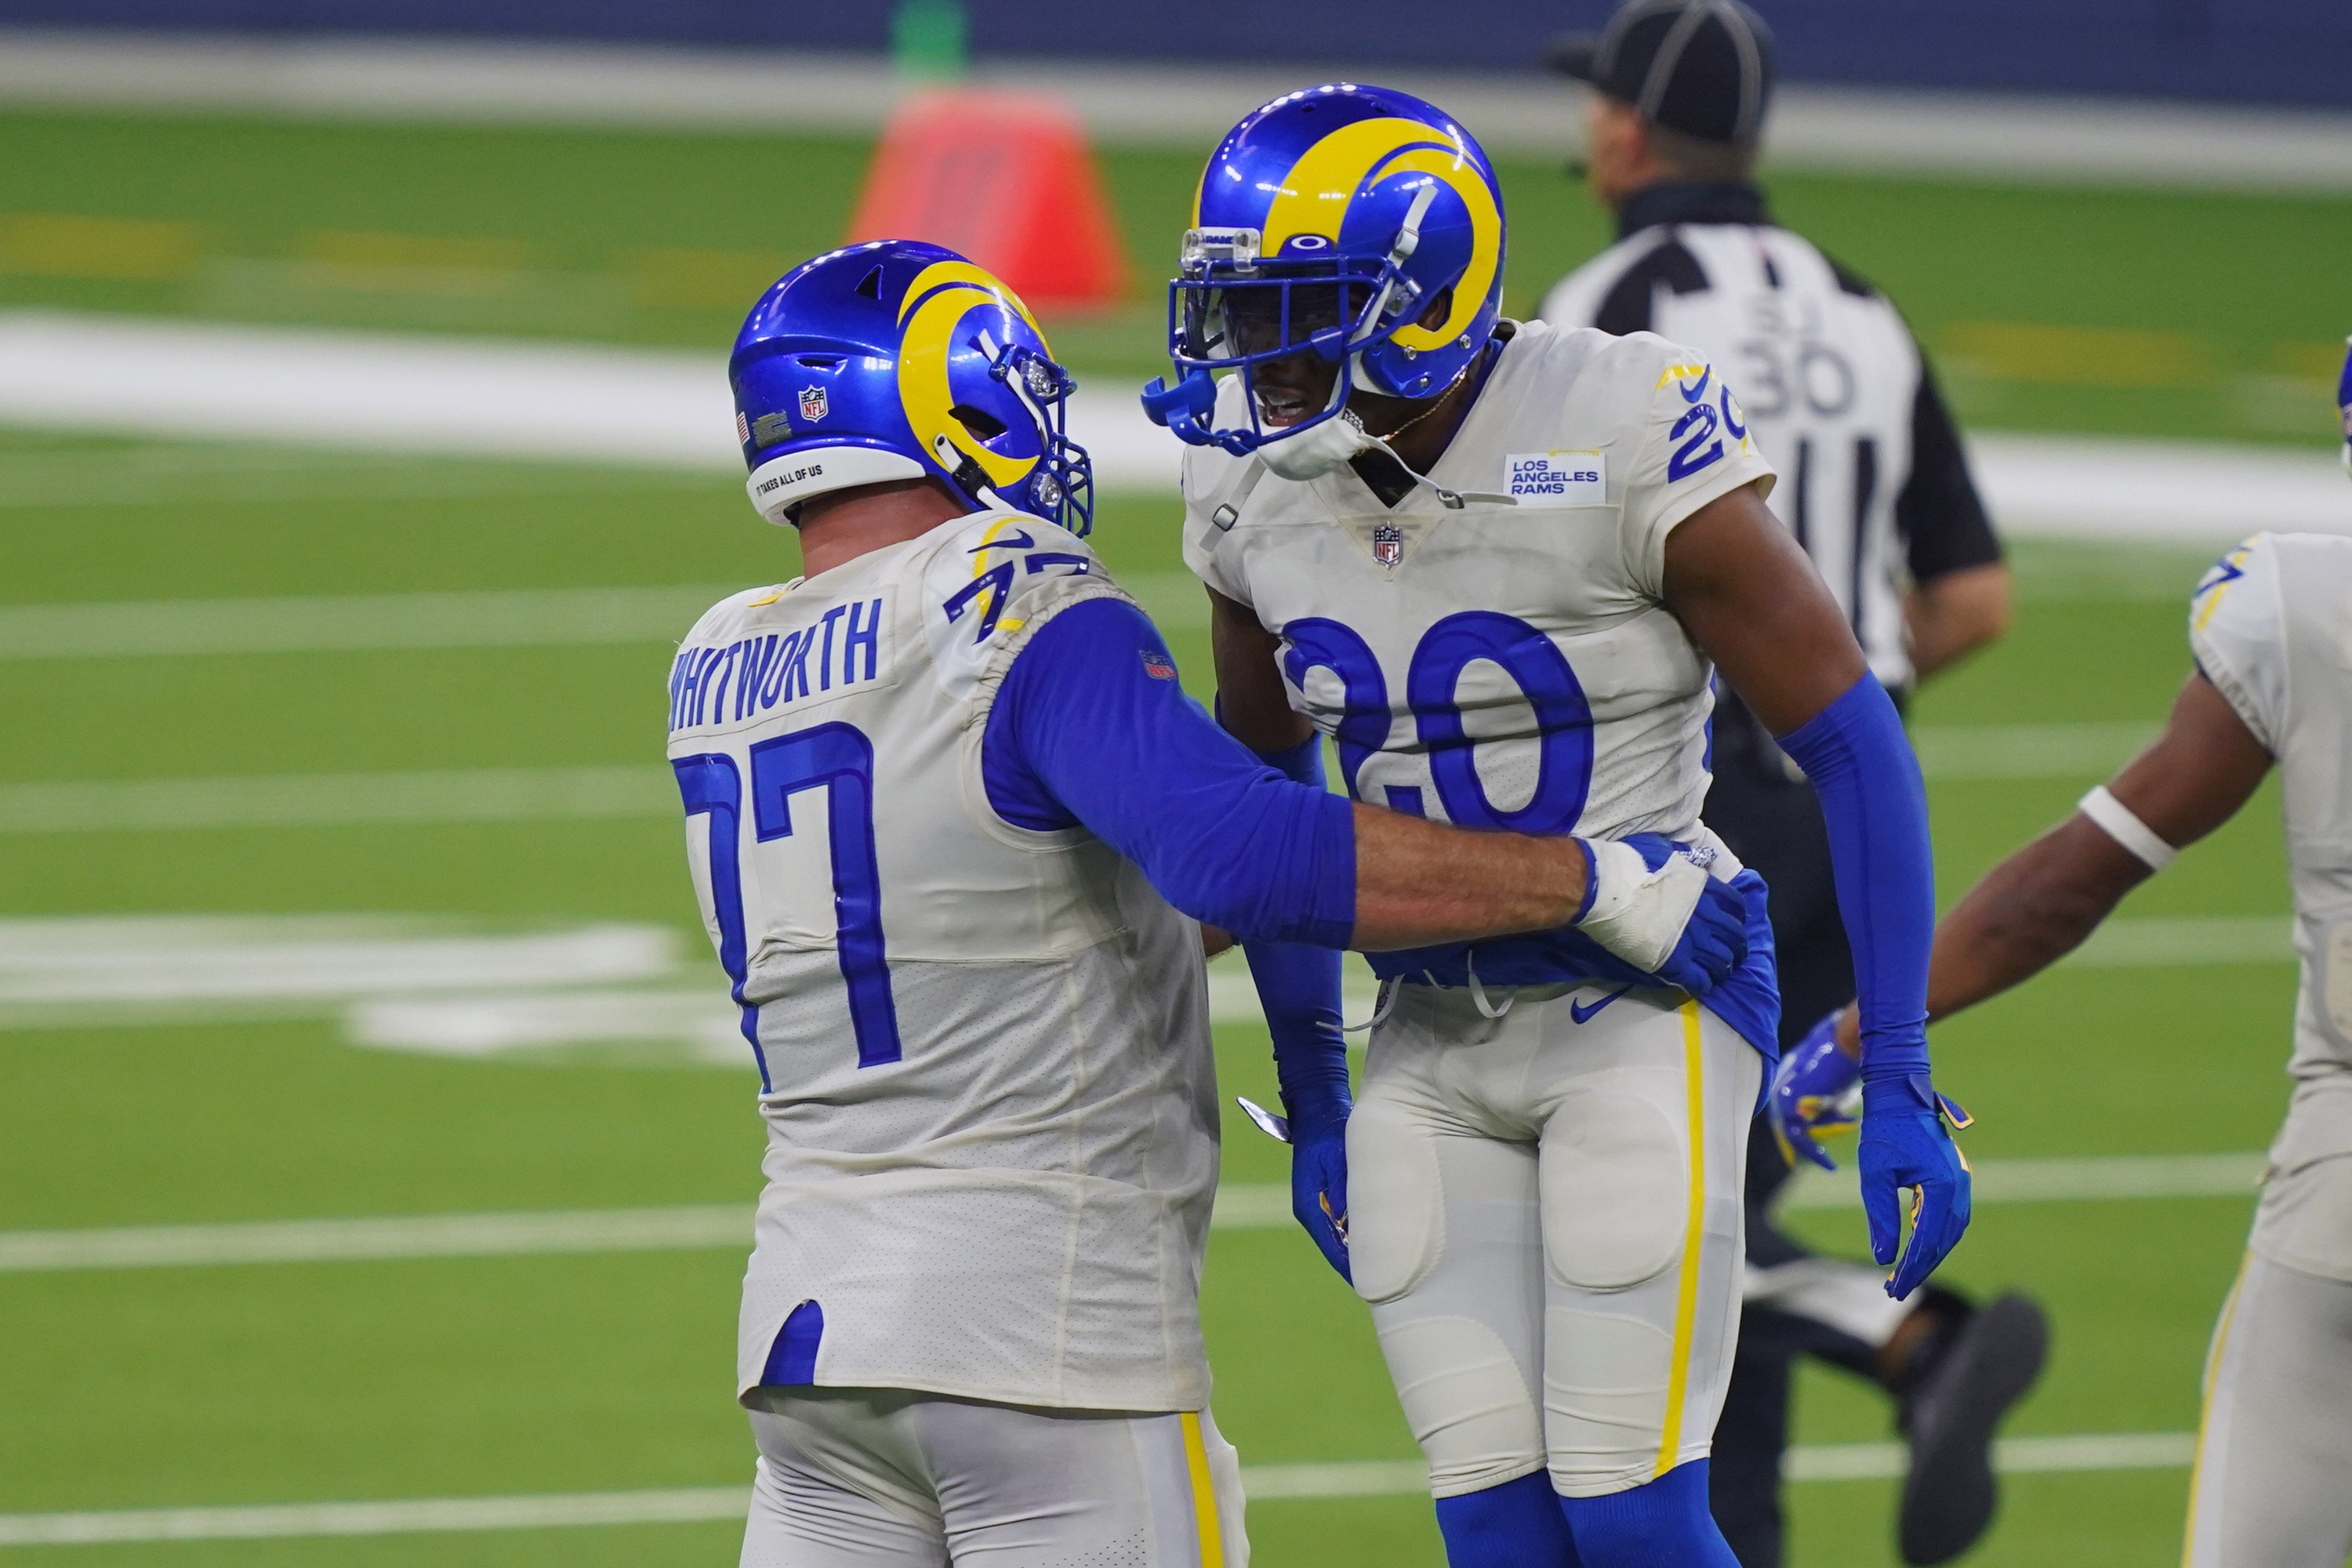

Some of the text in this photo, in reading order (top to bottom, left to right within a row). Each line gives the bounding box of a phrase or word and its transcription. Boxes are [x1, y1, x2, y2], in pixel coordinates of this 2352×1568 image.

[1735, 338, 1858, 420] 30
[804, 401, 825, 416] NFL
[1512, 460, 1548, 472] LOS
[1512, 471, 1599, 484] ANGELES
[760, 478, 779, 495] TAKES
[780, 472, 795, 486] ALL
[795, 468, 807, 481] OF
[808, 465, 822, 477] US
[1512, 483, 1565, 495] RAMS
[1377, 543, 1399, 560] NFL
[670, 598, 883, 732] WHITWORTH
[1283, 608, 1595, 837] 20
[673, 720, 902, 1094] 77
